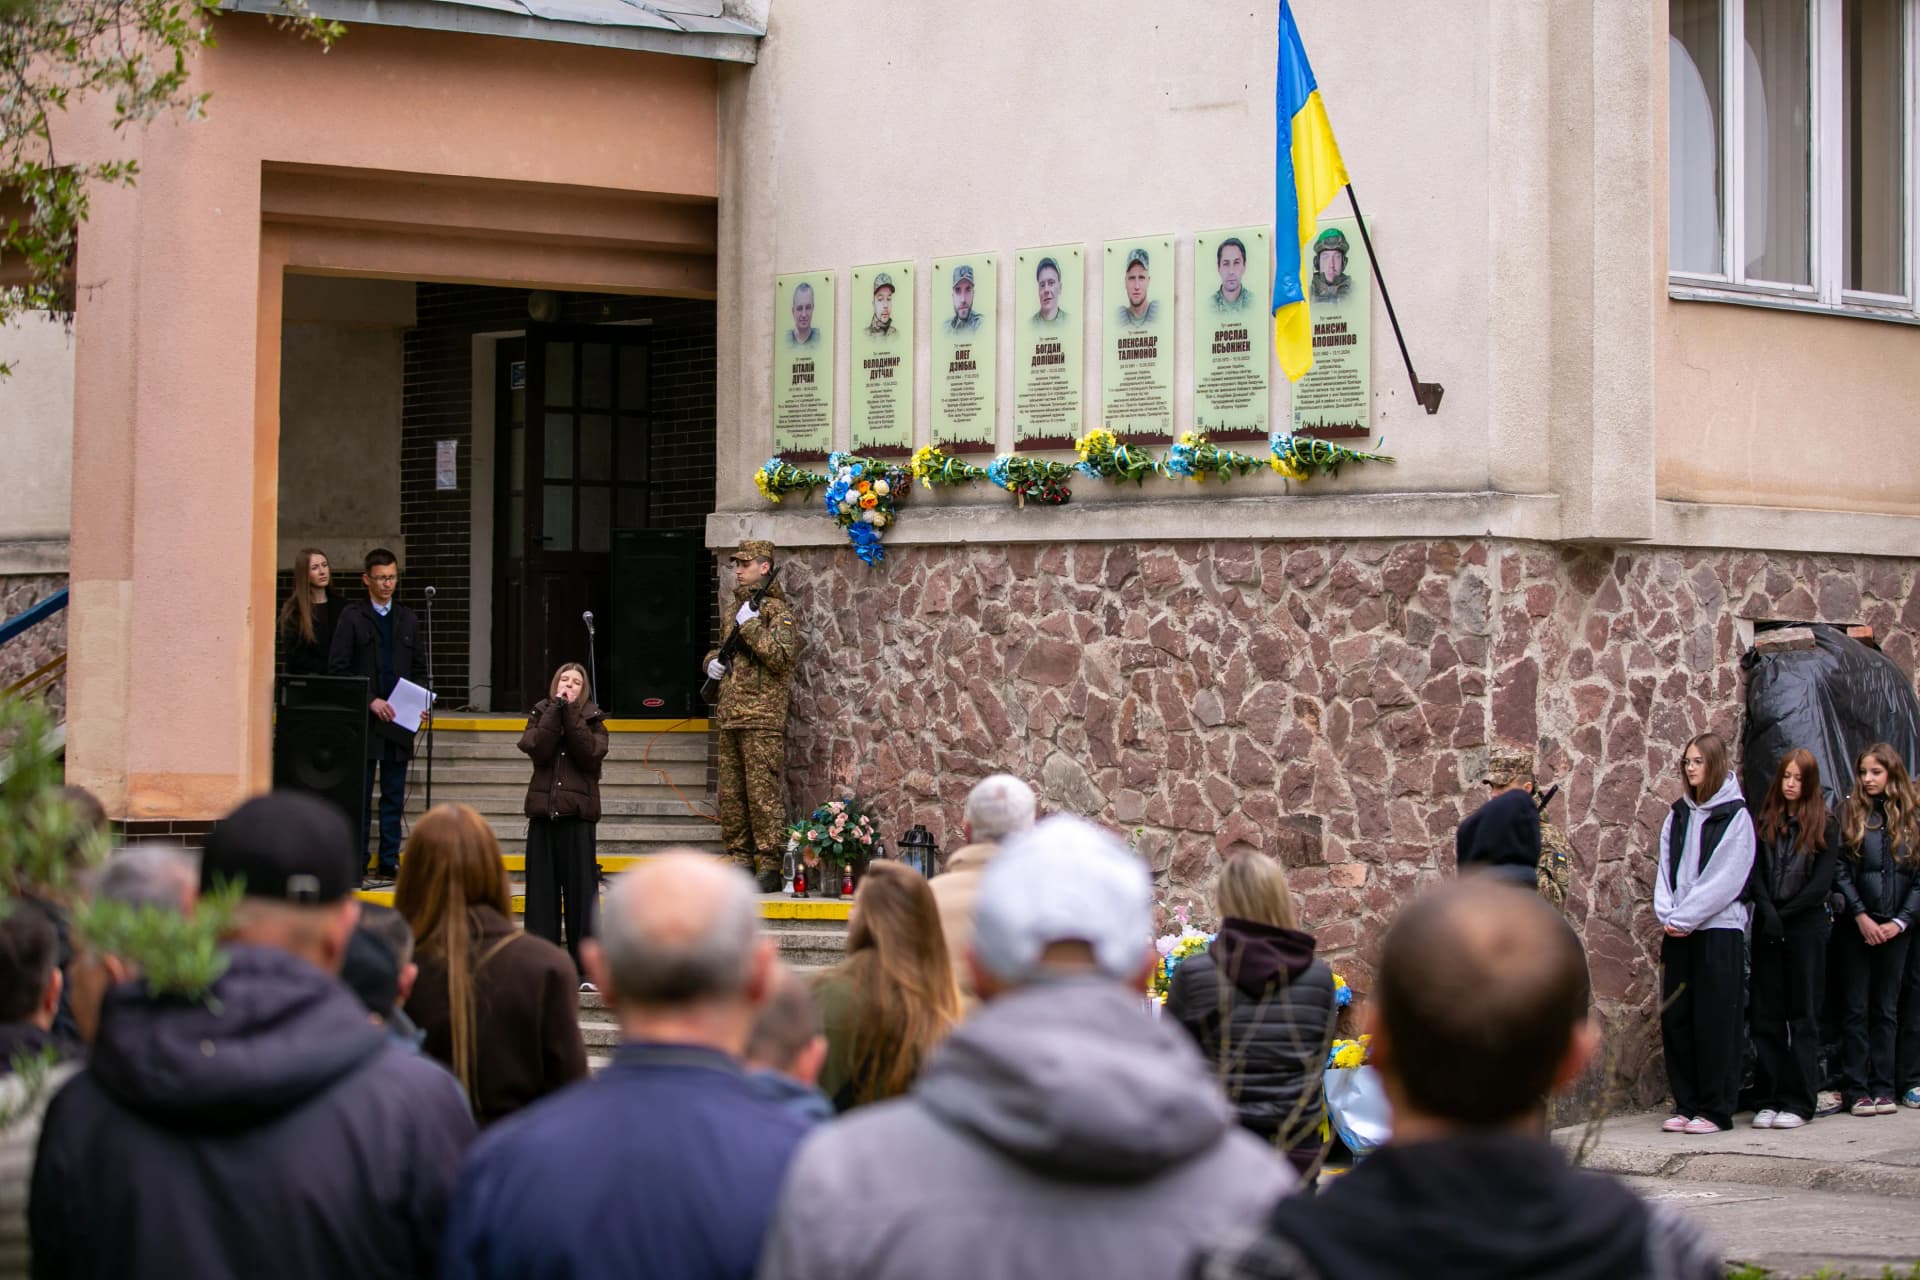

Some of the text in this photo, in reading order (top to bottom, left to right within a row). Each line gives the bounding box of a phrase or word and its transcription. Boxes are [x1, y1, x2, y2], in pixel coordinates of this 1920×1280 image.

[1314, 322, 1347, 335] МАКСИМ
[1117, 335, 1158, 349] ОЛЕКСАНДР
[1214, 329, 1248, 342] ЯРОСЛАВ
[1312, 334, 1357, 348] АПОШНІКОВ
[955, 349, 971, 361] ОЛЕГ
[1035, 342, 1061, 355] БОГДАН
[1118, 347, 1158, 361] ТАЛІМОНОВ
[863, 356, 901, 369] ВОЛОДИМИР
[1031, 352, 1065, 368] ДОЛІШНІЙ
[870, 367, 894, 381] ДУТЧАК
